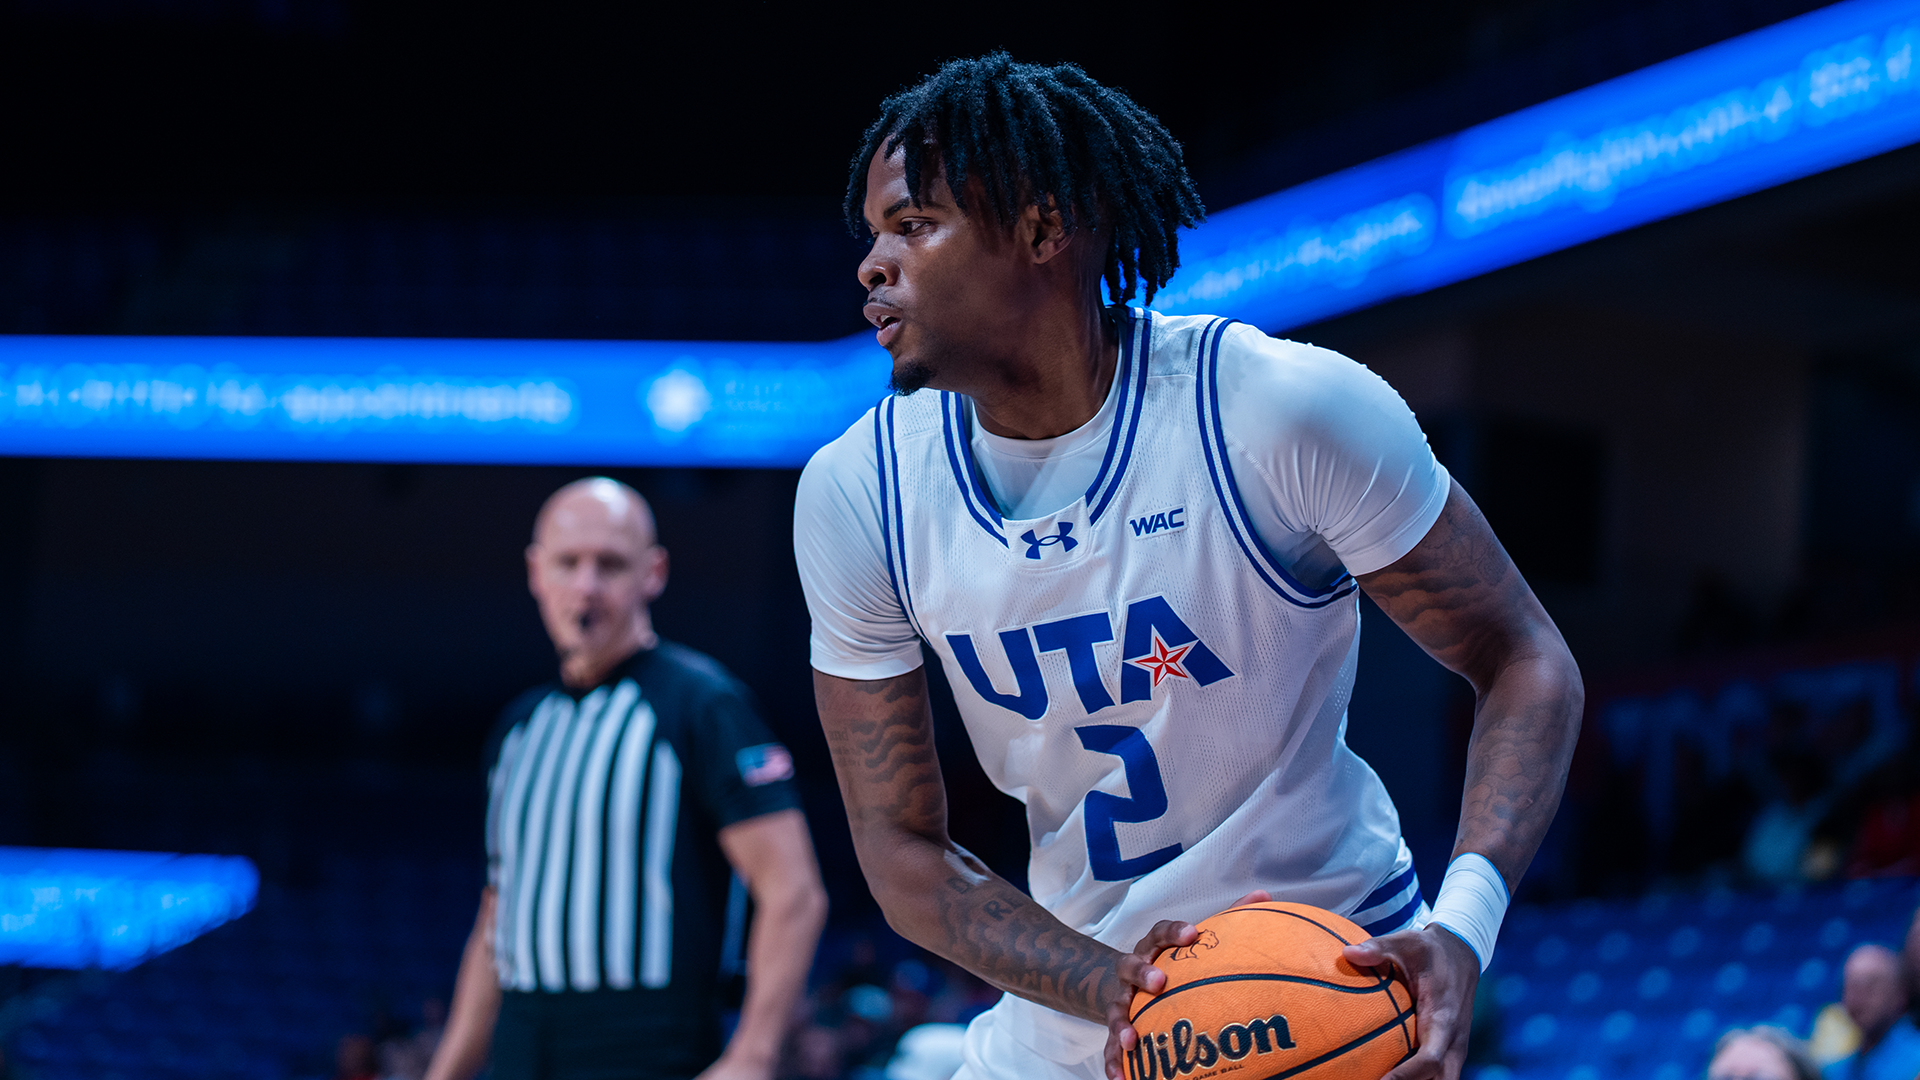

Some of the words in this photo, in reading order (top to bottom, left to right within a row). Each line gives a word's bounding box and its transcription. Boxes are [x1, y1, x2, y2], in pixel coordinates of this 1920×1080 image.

[1129, 507, 1185, 537] WAC
[945, 595, 1236, 721] UTA
[1074, 724, 1184, 882] 2
[1127, 1014, 1298, 1080] Wilson
[1220, 1063, 1246, 1074] BALL
